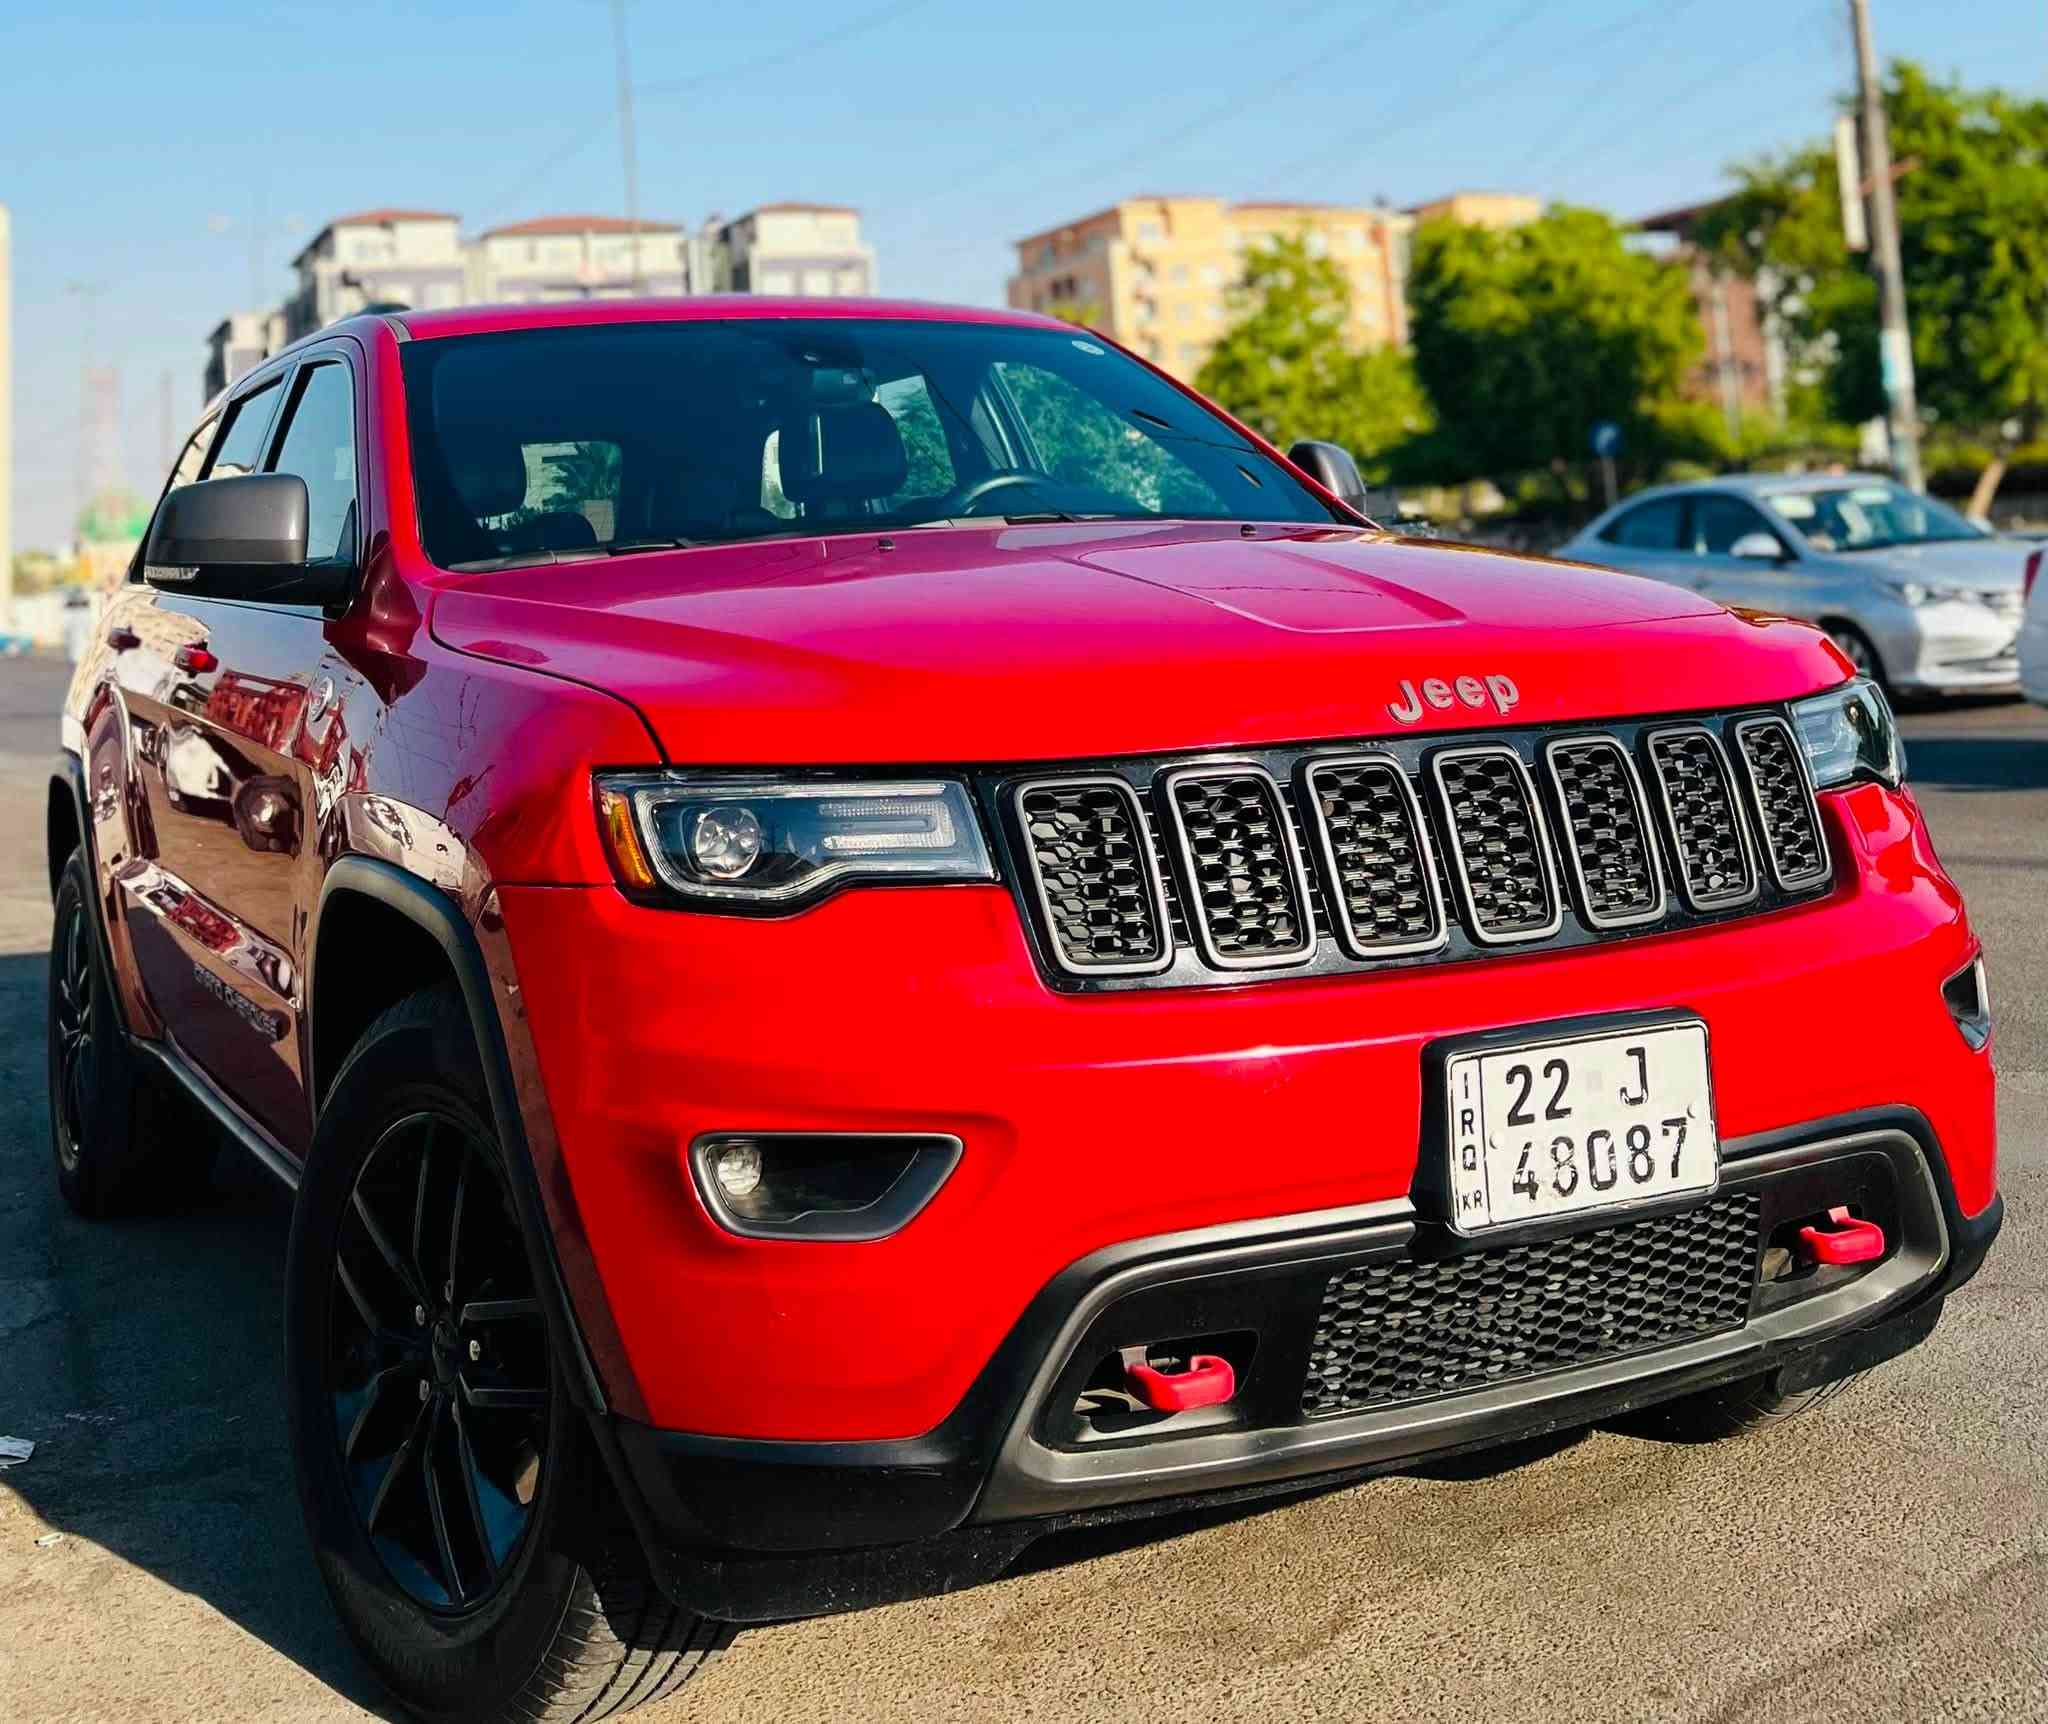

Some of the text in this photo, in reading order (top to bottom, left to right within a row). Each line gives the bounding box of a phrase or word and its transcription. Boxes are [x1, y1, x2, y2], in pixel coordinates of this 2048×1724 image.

[1387, 674, 1520, 724] Jeep
[1506, 1047, 1649, 1127] 22 J
[1512, 1117, 1688, 1203] 48087
[1462, 1189, 1483, 1211] KR
